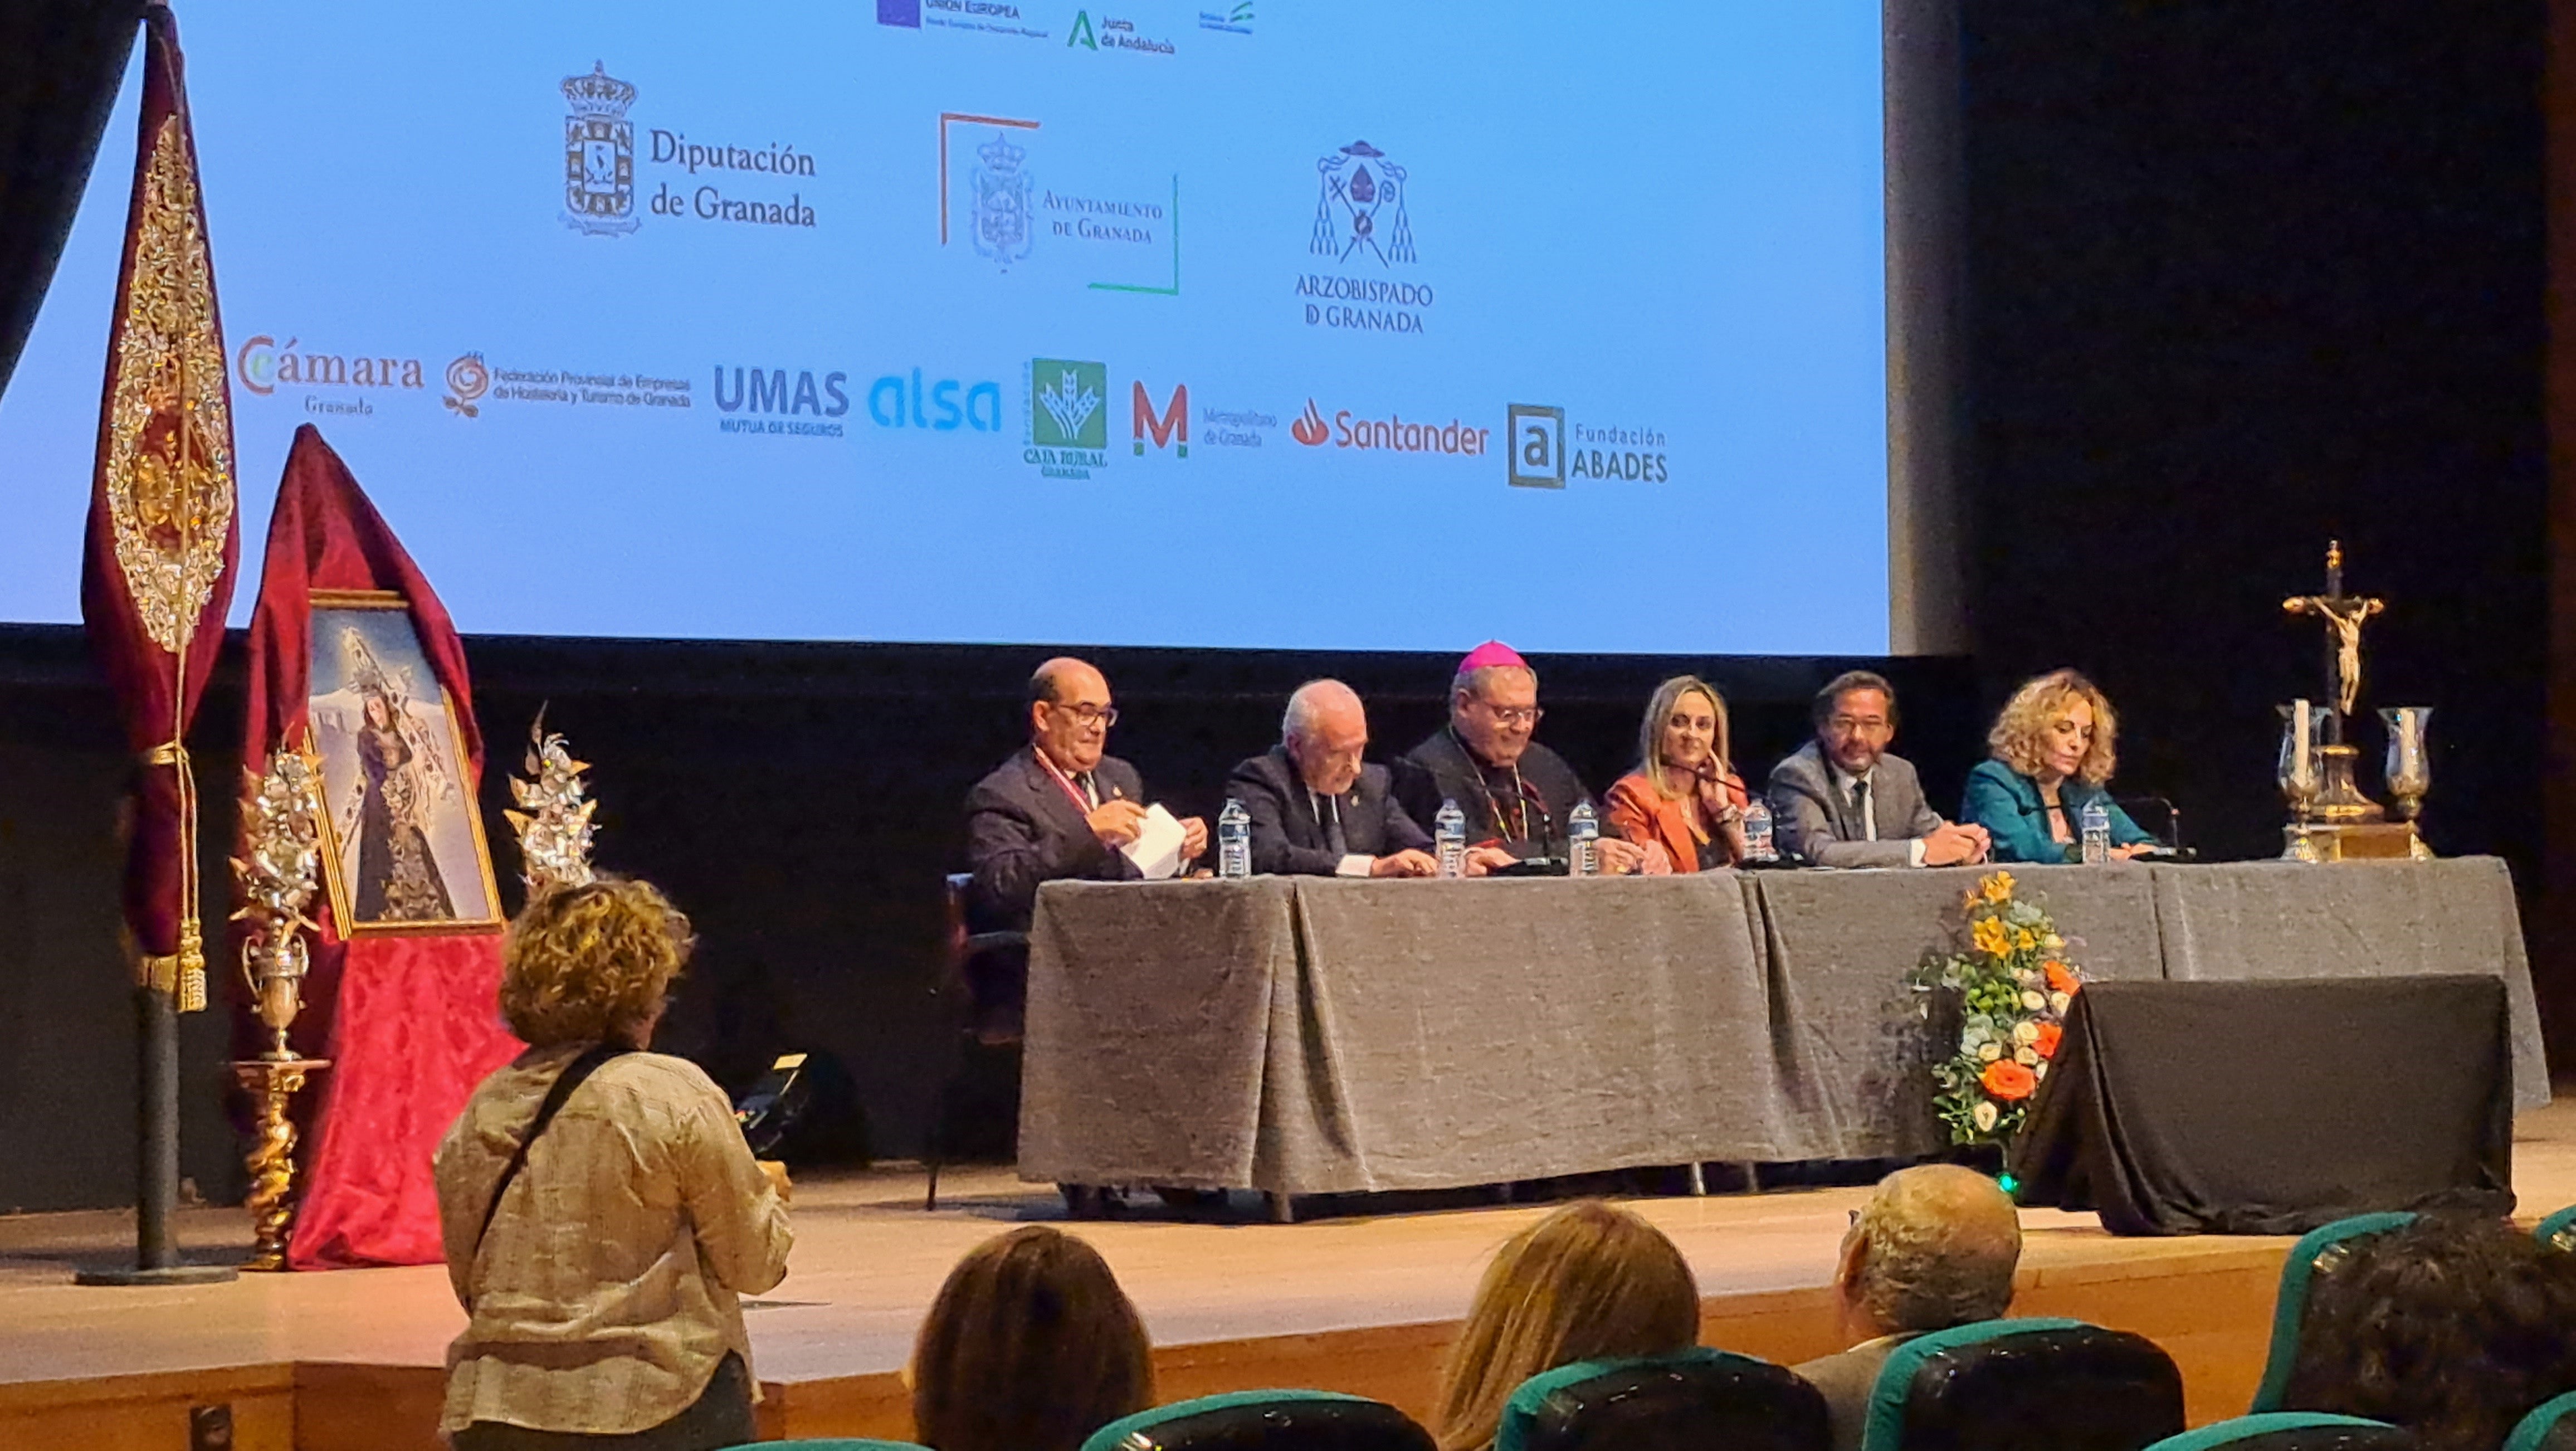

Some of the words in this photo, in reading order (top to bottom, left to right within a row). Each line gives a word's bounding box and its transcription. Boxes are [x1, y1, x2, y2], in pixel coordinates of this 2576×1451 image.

[650, 129, 816, 176] Diputación
[651, 183, 685, 216] de
[694, 186, 816, 227] Granada
[1077, 217, 1152, 244] GRANADA
[1295, 274, 1433, 307] ARZOBISPADO
[1326, 305, 1424, 334] GRANADA
[237, 334, 425, 396] Cámara
[714, 364, 850, 417] UMAS
[868, 366, 1001, 432] alsa
[1335, 410, 1489, 456] Santander
[1575, 423, 1666, 447] Fundación
[1572, 449, 1668, 484] ABADES
